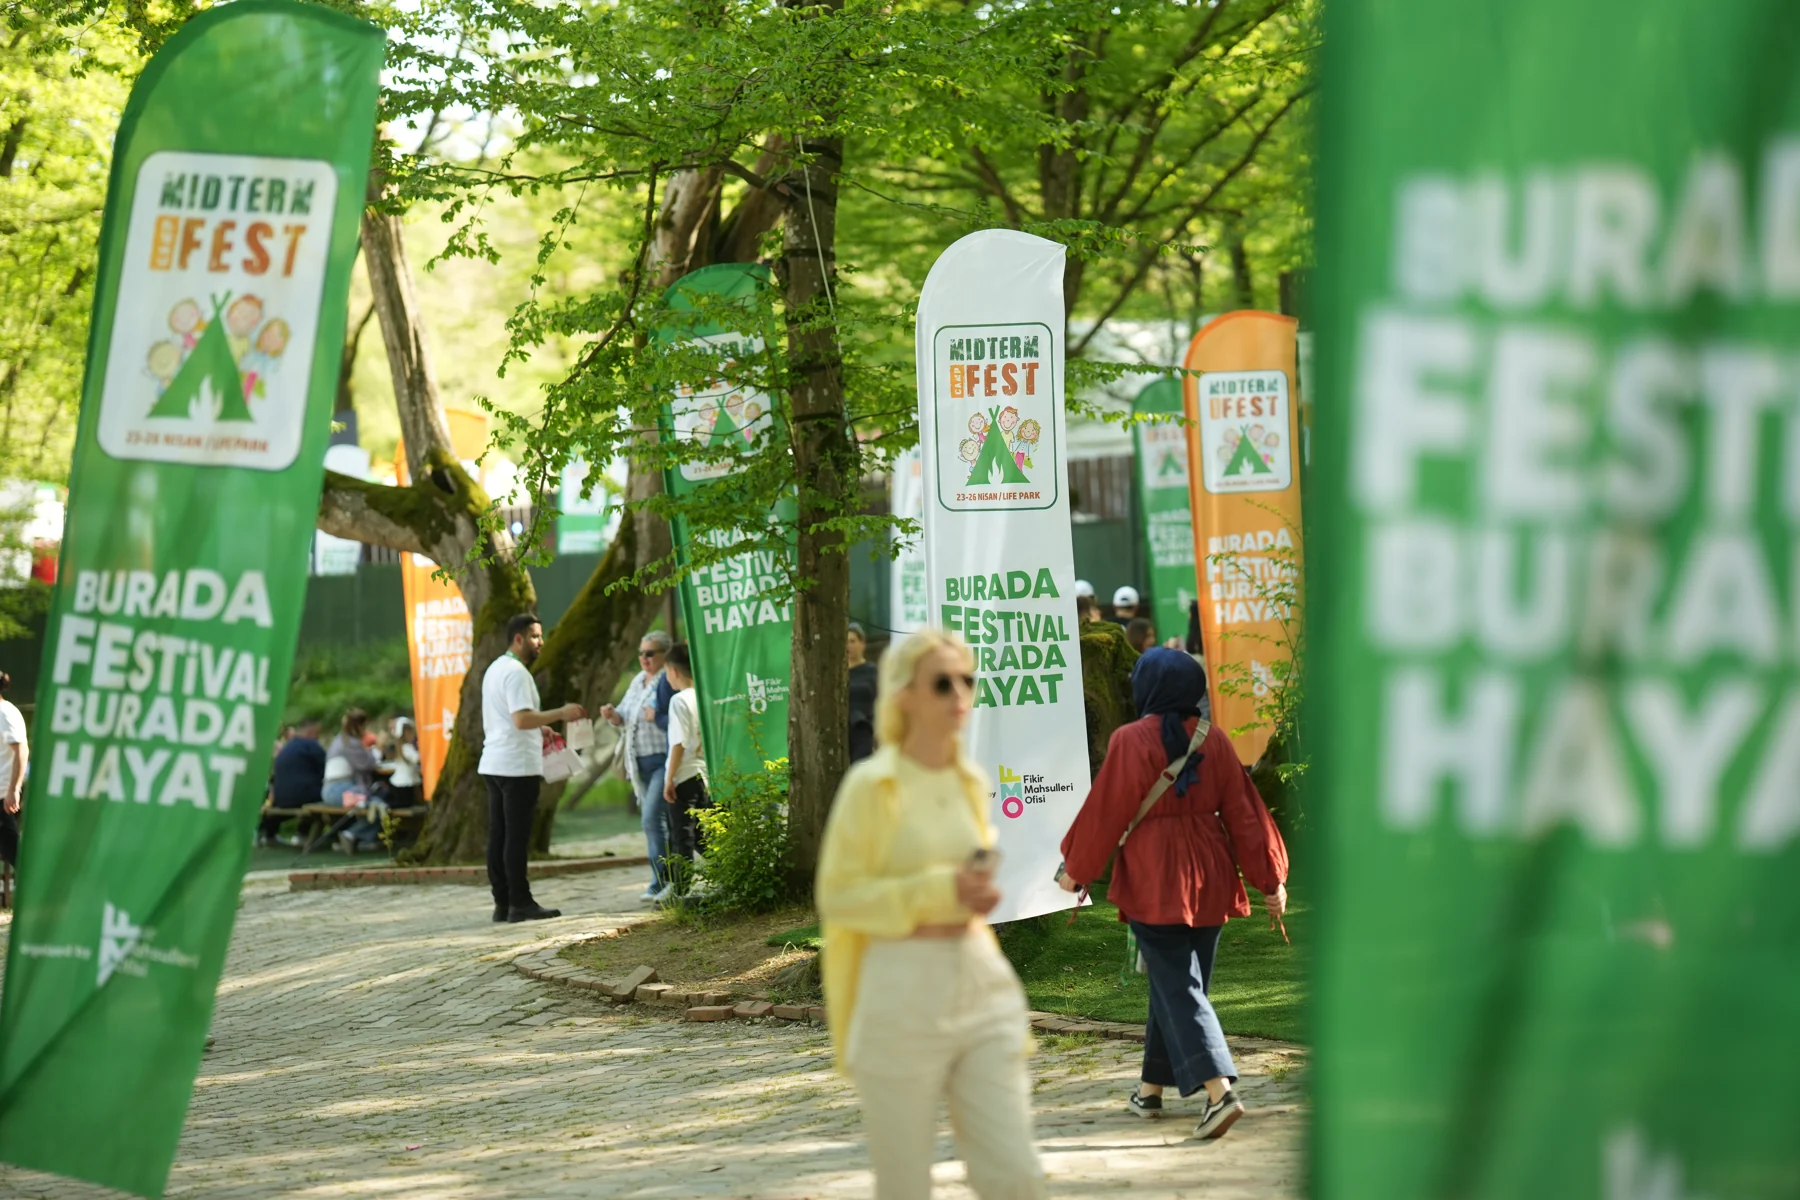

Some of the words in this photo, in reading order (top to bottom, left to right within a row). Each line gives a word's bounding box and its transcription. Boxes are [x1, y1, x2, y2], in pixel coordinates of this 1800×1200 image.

[159, 172, 316, 215] MIDTERM
[177, 217, 307, 278] FEST
[950, 336, 1039, 361] MIDTERM
[967, 362, 1039, 397] FEST
[1223, 395, 1278, 418] FEST
[1352, 300, 1800, 523] FEST
[956, 493, 977, 501] 23-26
[1002, 492, 1017, 500] LIFE
[1019, 491, 1040, 500] PARK
[1208, 527, 1293, 554] BURADA
[74, 569, 273, 628] BURADA
[946, 568, 1060, 601] BURADA
[704, 596, 794, 635] HAYAT
[973, 673, 1063, 708] AYAT
[51, 688, 256, 752] BURADA
[48, 741, 248, 813] HAYAT
[1023, 774, 1044, 784] Fikir
[1024, 783, 1074, 794] Mahsulleri
[1025, 795, 1046, 804] Ofisi
